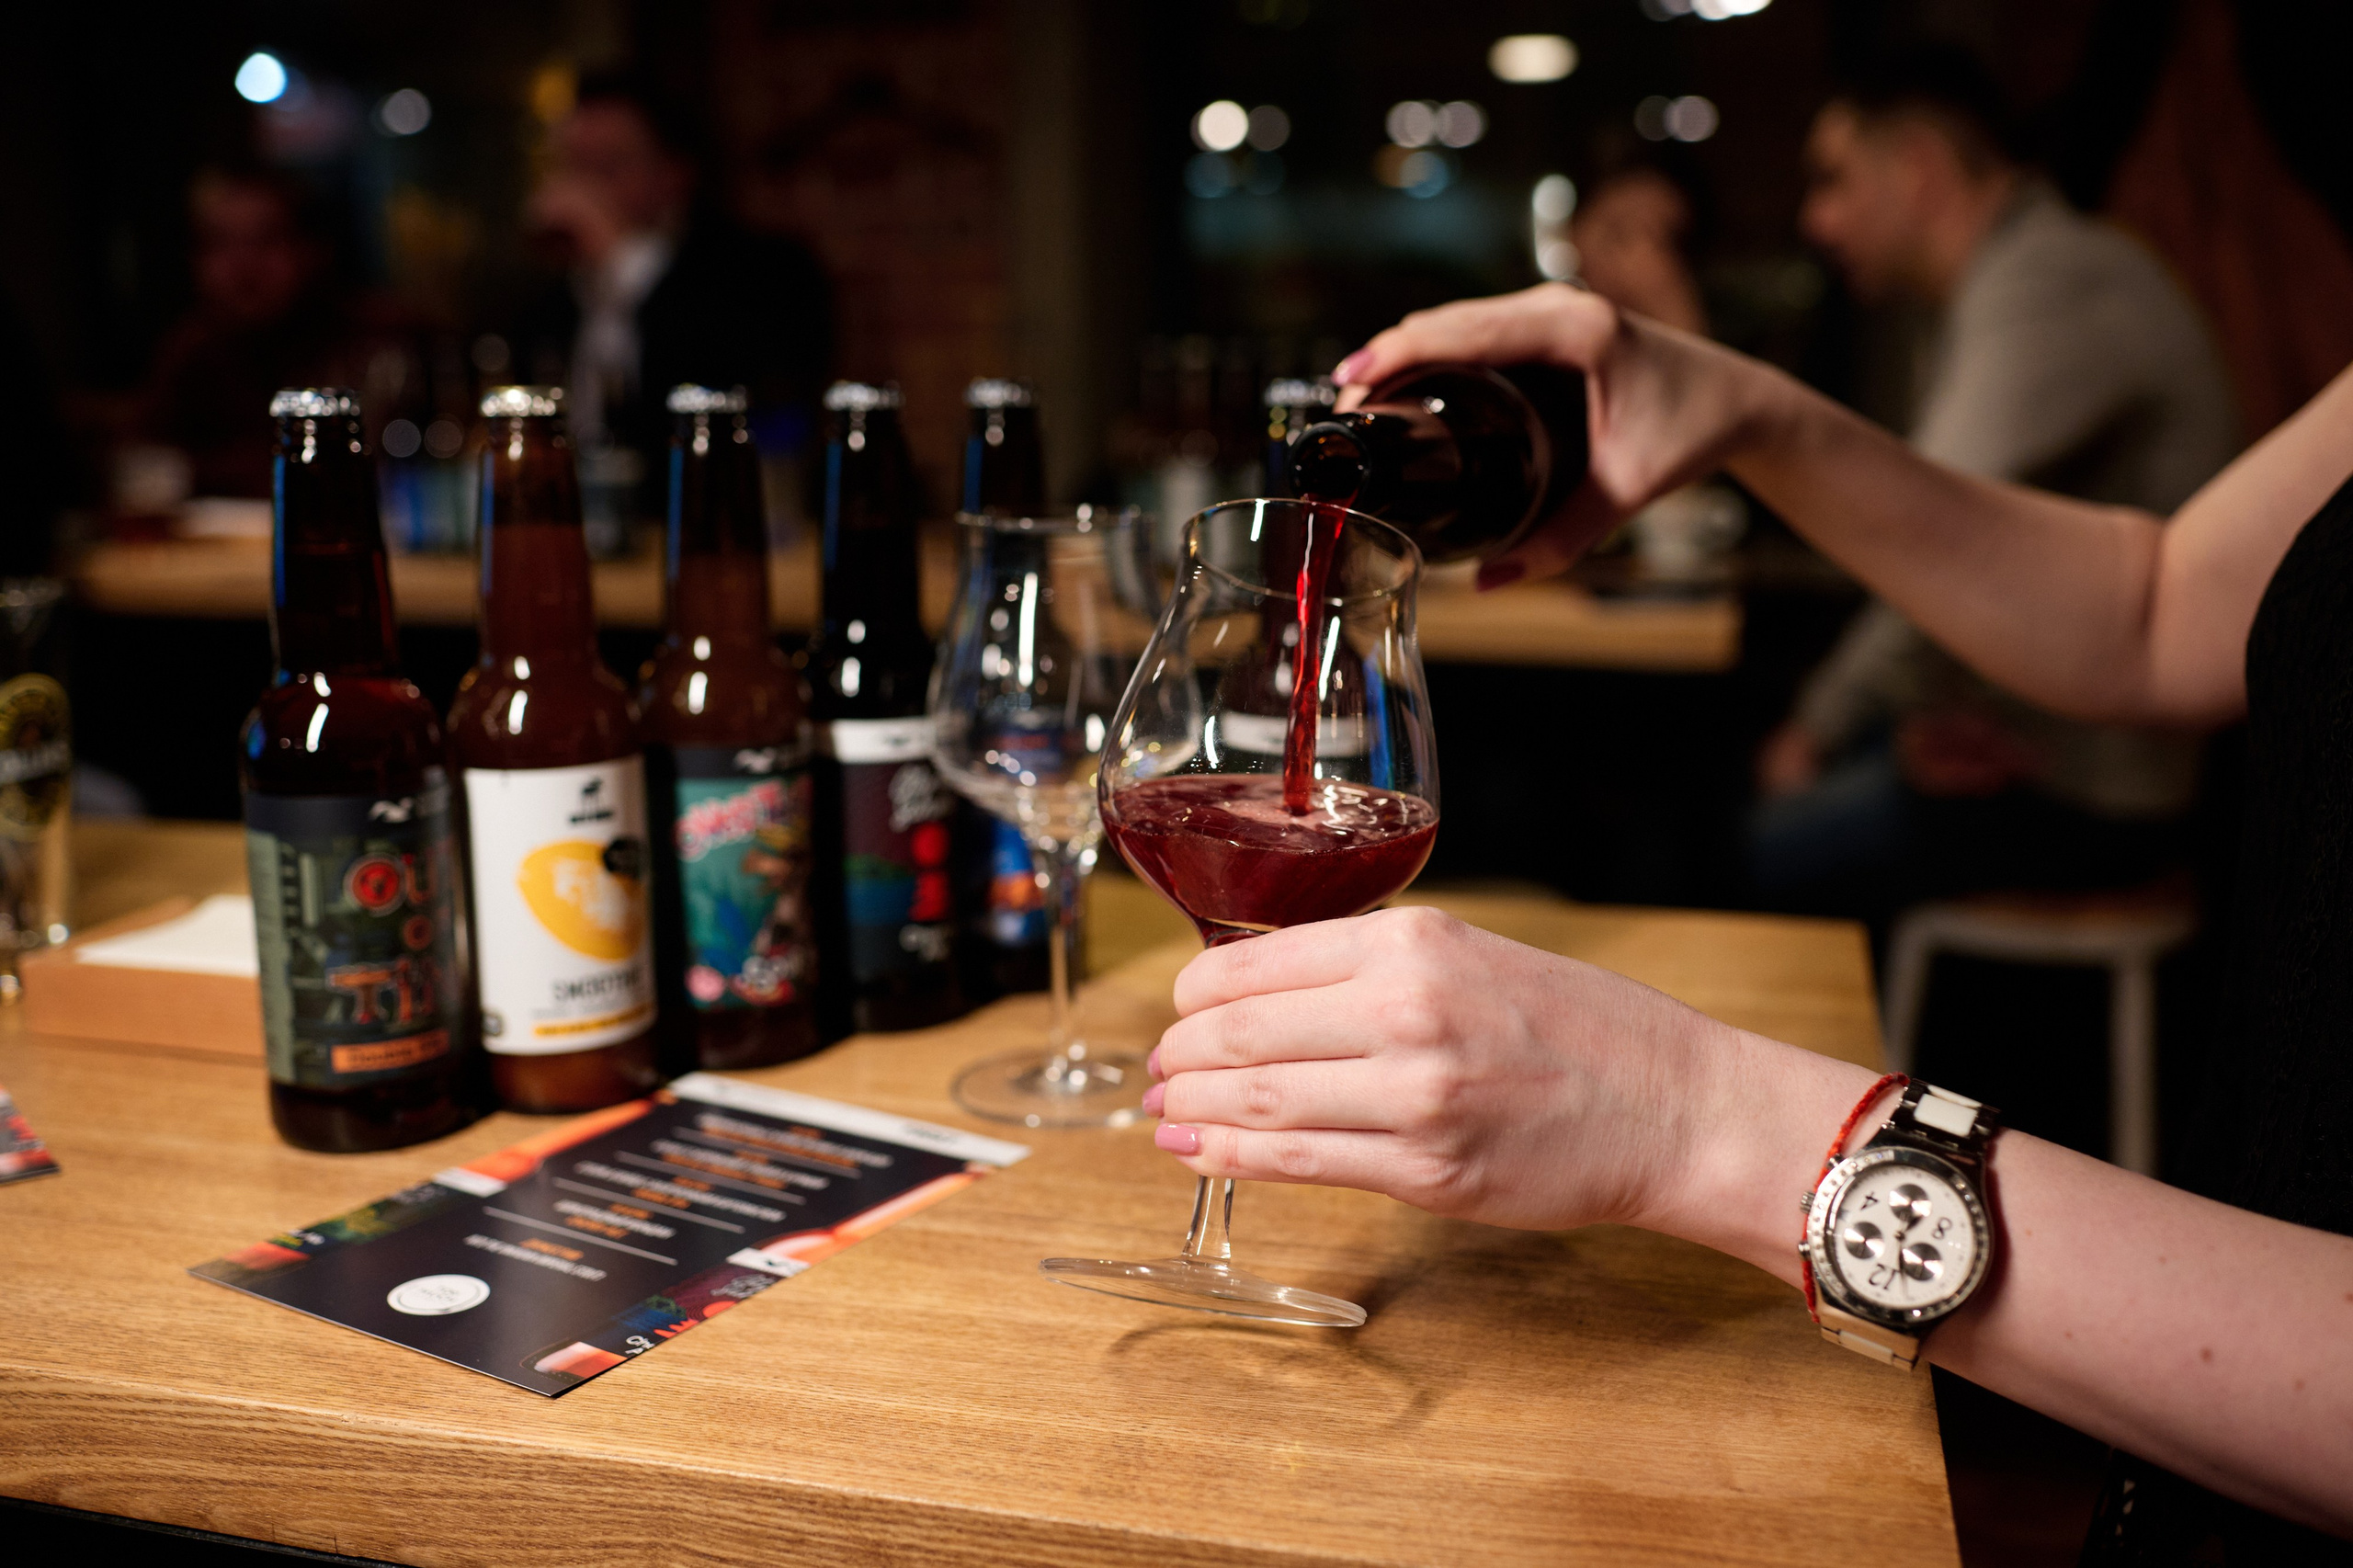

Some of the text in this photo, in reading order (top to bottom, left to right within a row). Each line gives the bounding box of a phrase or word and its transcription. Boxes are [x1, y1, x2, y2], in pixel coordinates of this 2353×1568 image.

[1861, 1192, 1879, 1210] 4
[1931, 1217, 1953, 1240] 8
[1868, 1262, 1900, 1290] 12
